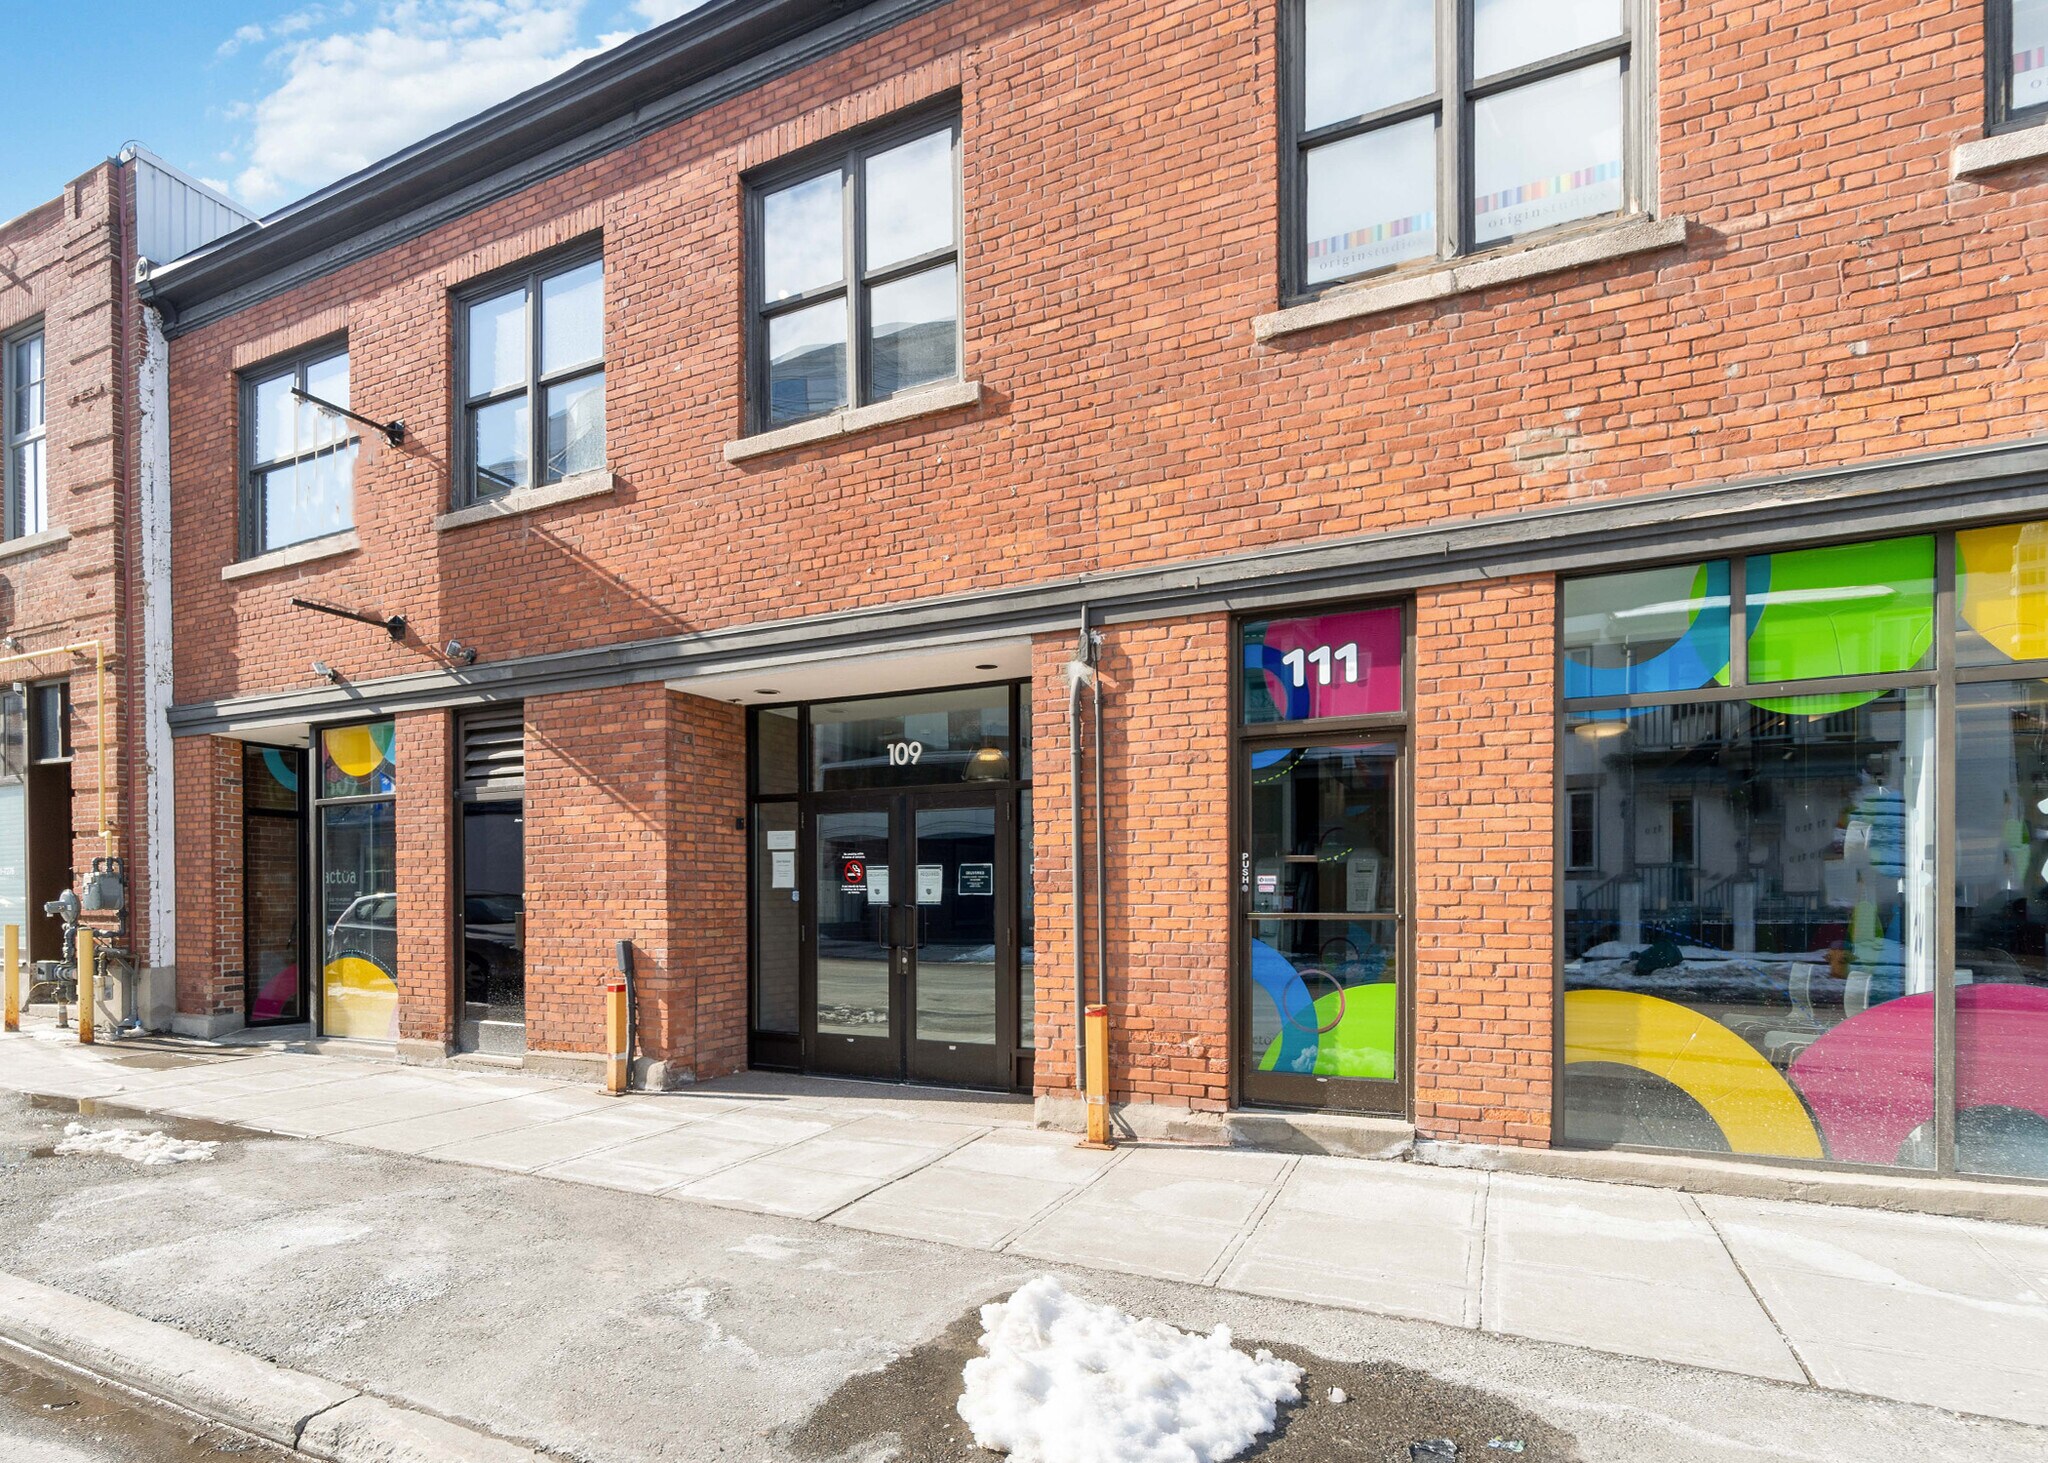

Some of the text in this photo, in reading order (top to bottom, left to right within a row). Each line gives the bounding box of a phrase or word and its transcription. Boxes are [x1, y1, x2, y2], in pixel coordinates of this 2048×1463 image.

[1488, 191, 1608, 228] originstudios
[1319, 236, 1425, 270] originstudios
[1282, 643, 1358, 688] 111
[886, 741, 922, 766] 109
[1242, 852, 1250, 884] PUSH
